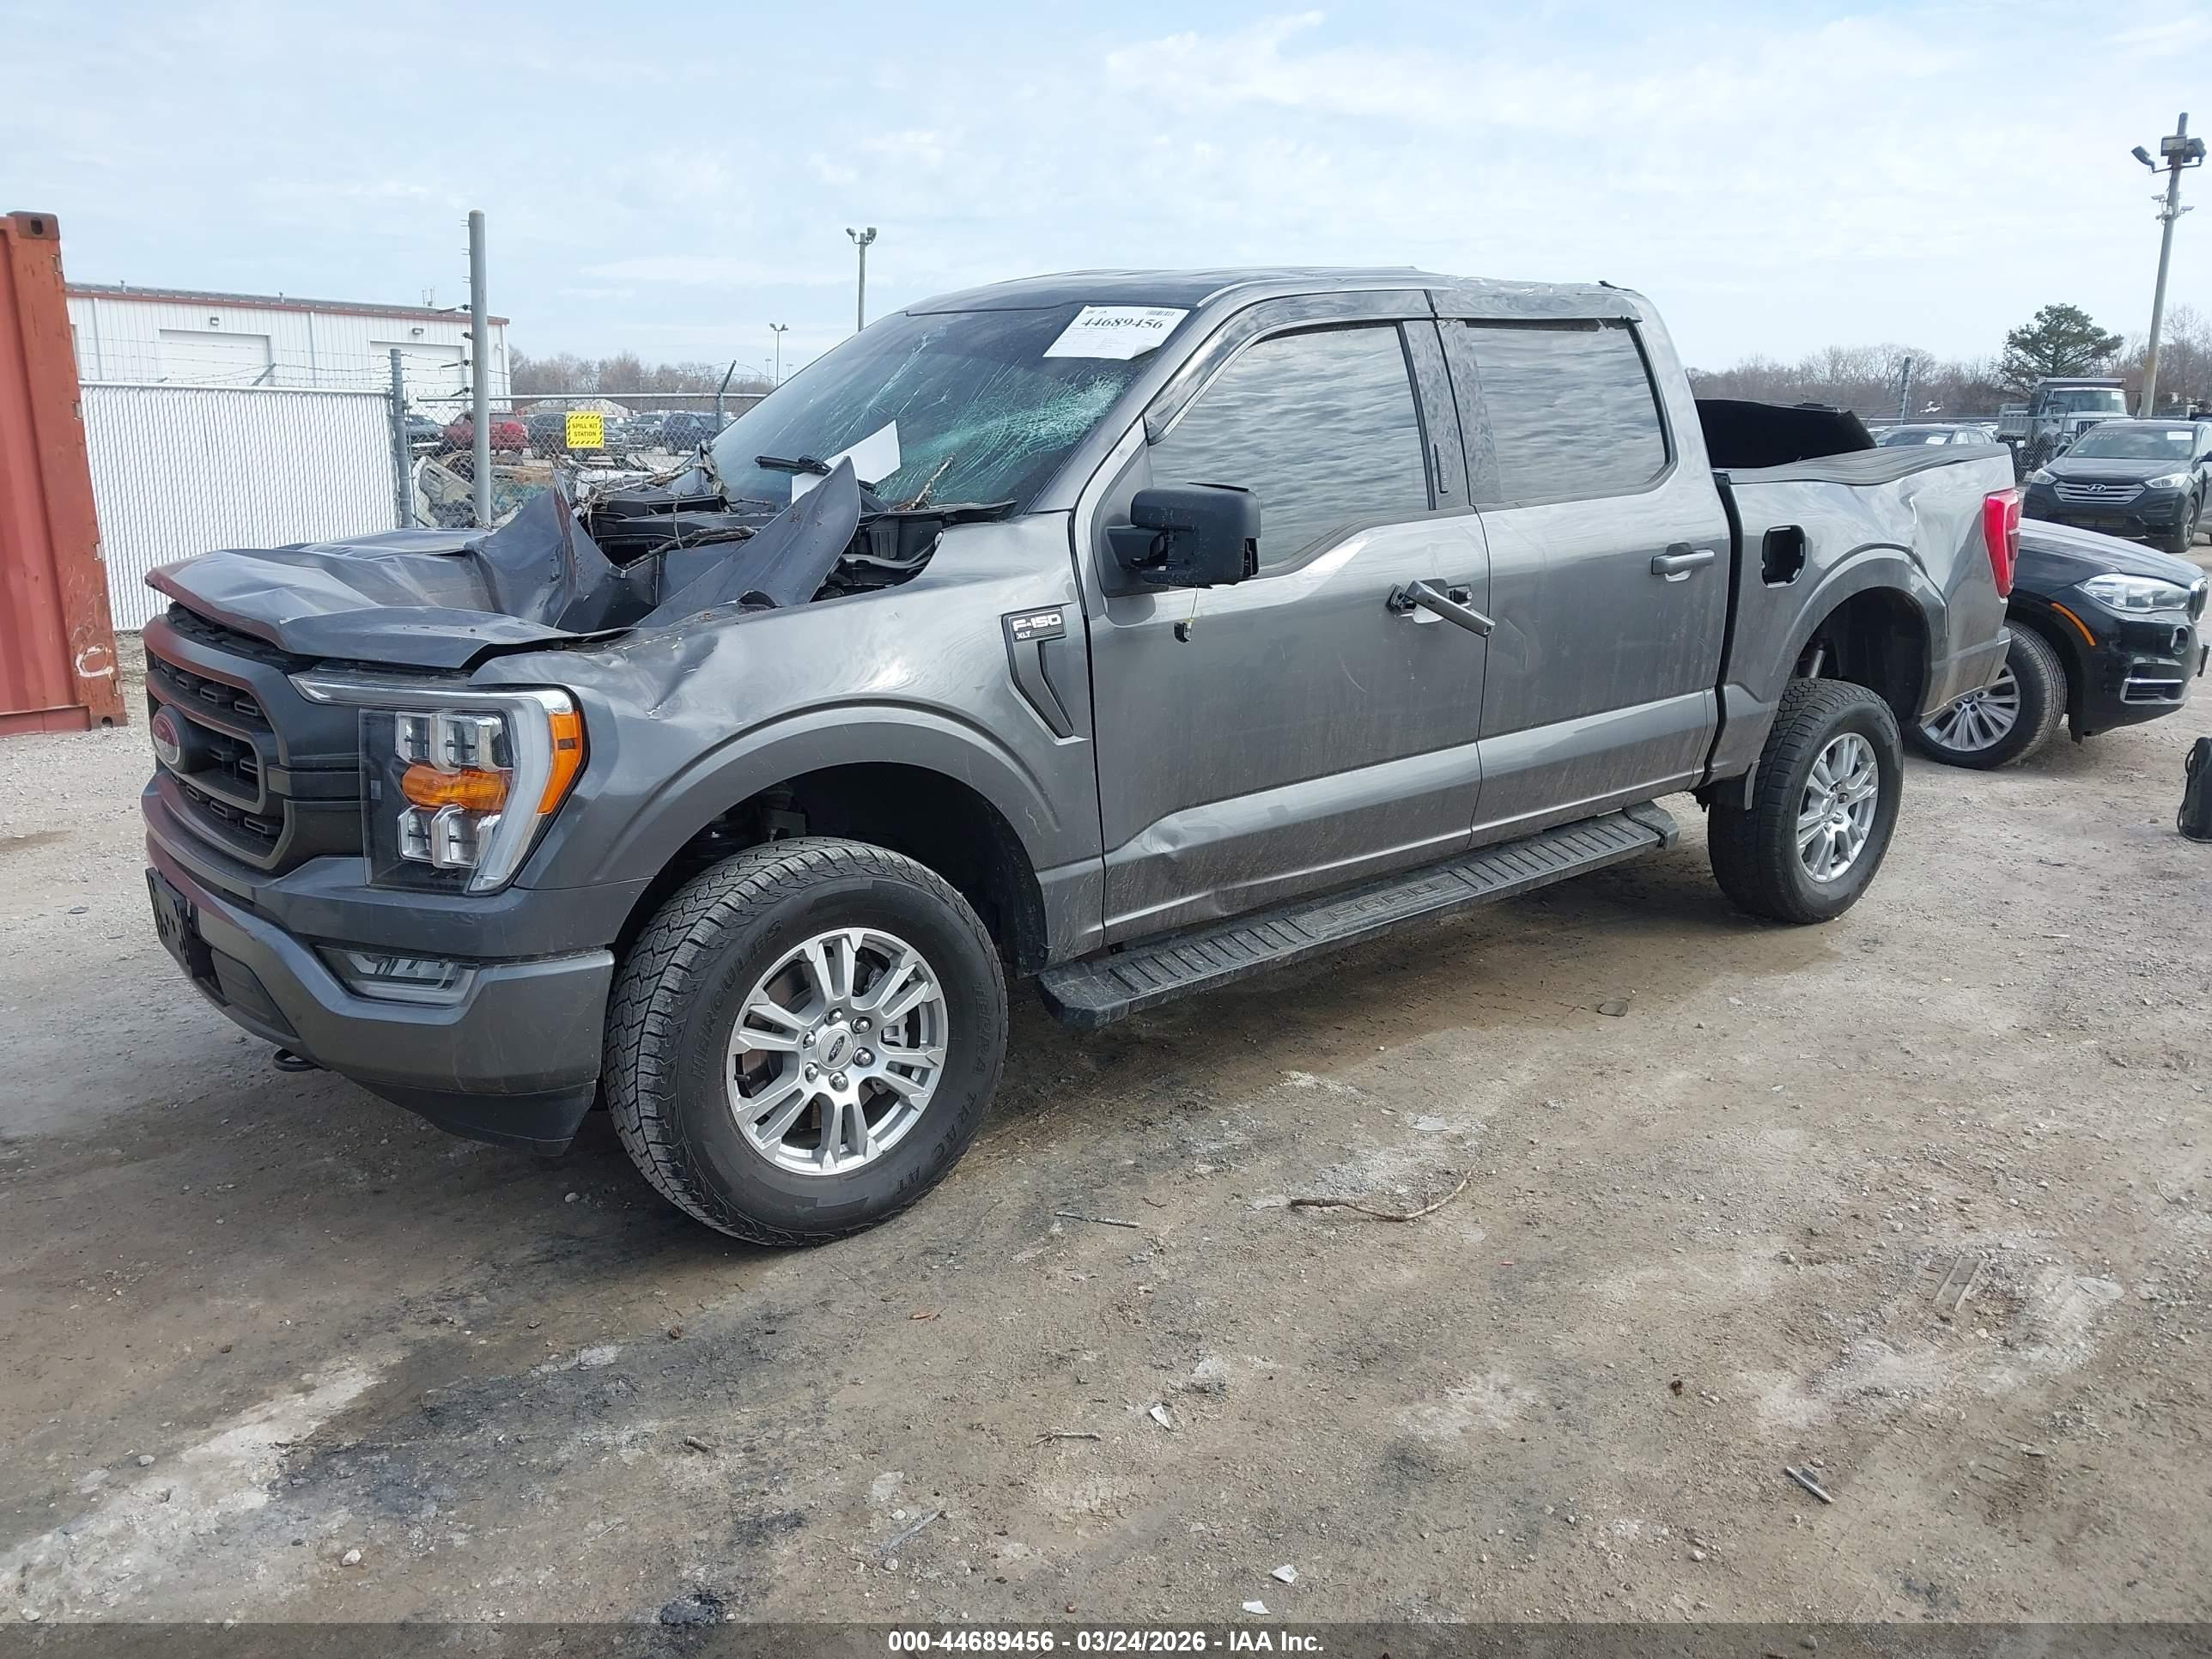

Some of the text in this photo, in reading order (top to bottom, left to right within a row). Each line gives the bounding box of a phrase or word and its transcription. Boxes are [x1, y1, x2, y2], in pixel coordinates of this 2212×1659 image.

[1081, 317, 1167, 330] 44689456
[1013, 614, 1062, 632] F-150
[1016, 630, 1031, 640] XLT
[690, 920, 783, 1079] HERCULES
[972, 981, 991, 1074] TERRA
[932, 1091, 978, 1162] TRAC
